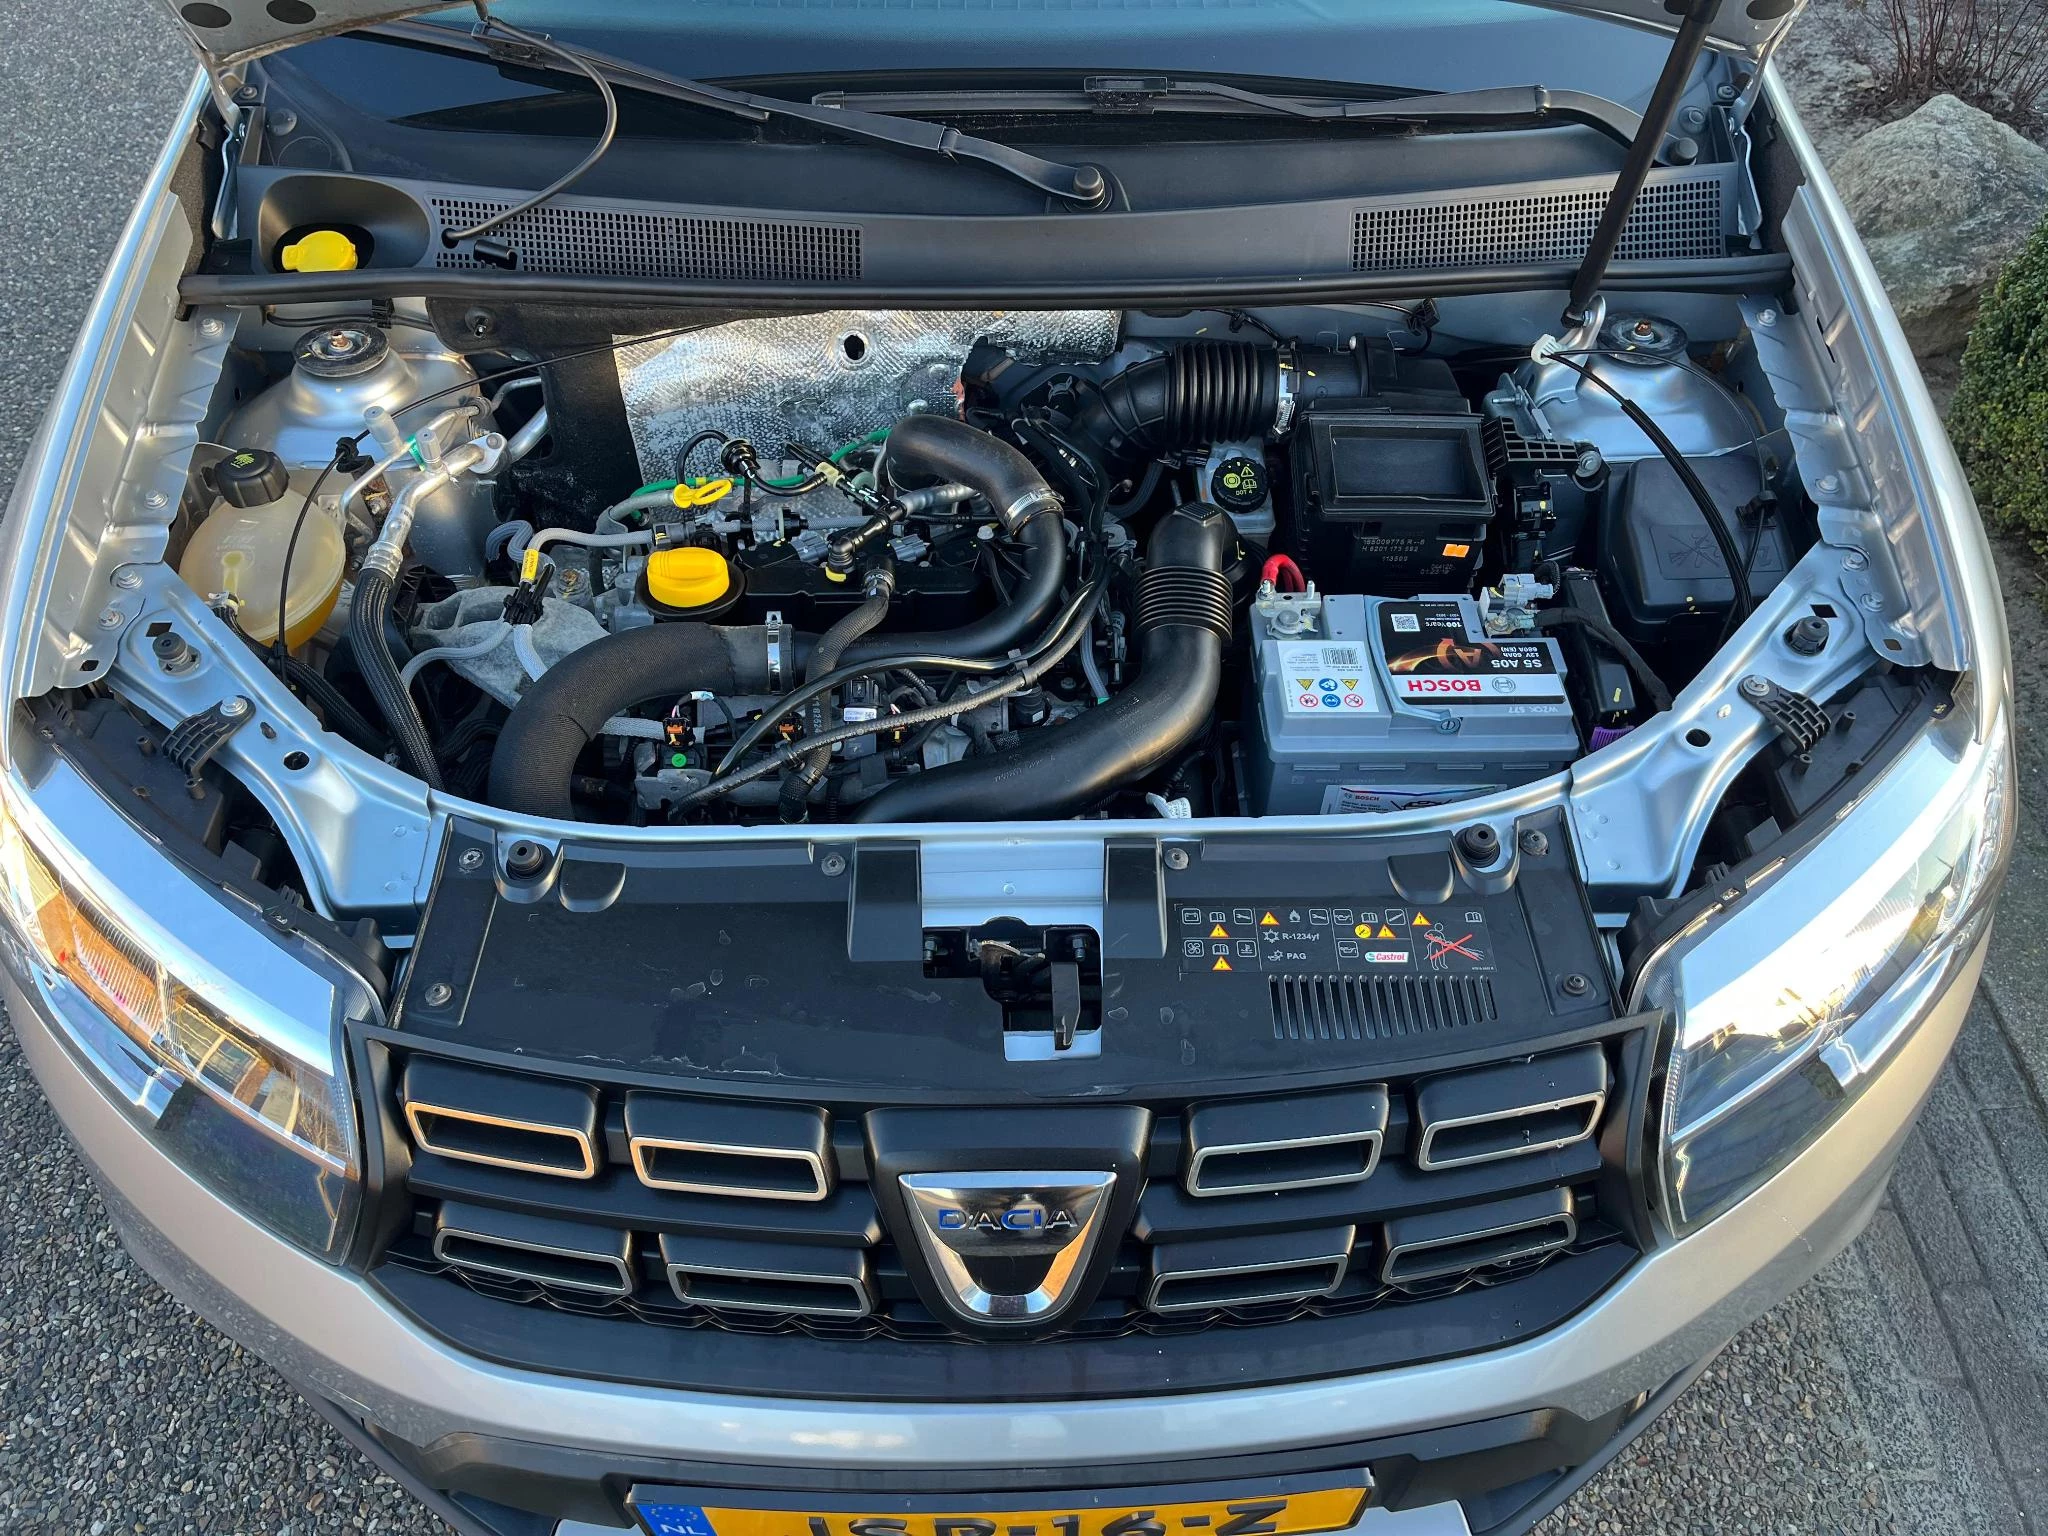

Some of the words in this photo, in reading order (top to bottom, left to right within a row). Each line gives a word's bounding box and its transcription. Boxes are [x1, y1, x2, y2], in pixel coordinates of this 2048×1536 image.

[1491, 659, 1519, 668] A05
[1523, 659, 1543, 668] S5
[1407, 679, 1482, 692] BOSCH
[1282, 932, 1320, 942] R-1234yf
[1286, 952, 1307, 960] PAG
[1376, 953, 1406, 961] Castrol
[938, 1208, 1078, 1231] DACIA
[660, 1523, 708, 1536] NL
